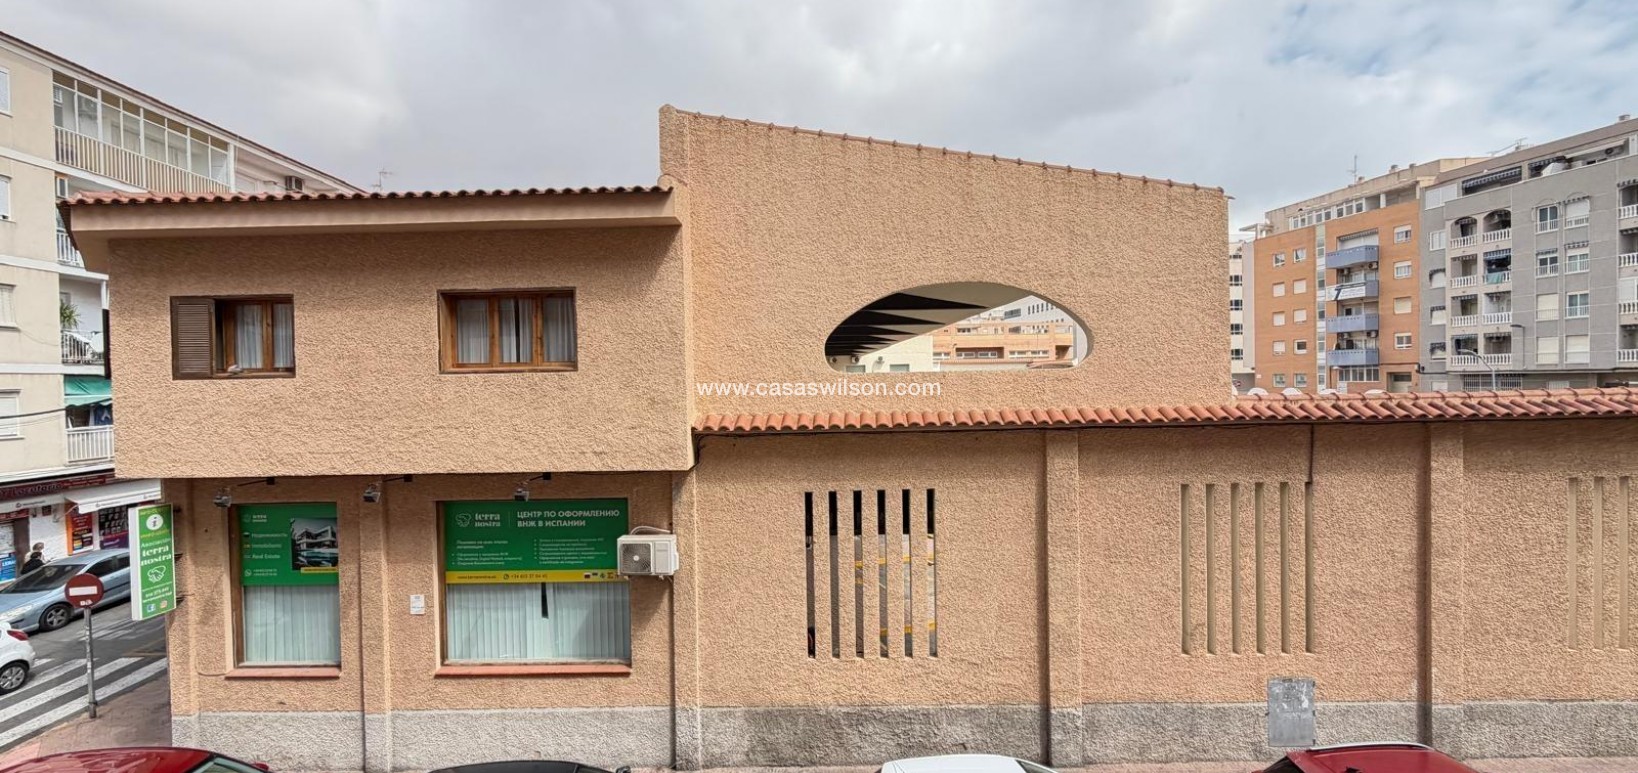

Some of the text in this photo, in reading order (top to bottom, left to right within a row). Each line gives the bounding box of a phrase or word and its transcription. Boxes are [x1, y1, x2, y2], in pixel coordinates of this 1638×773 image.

[474, 512, 501, 520] terra
[517, 509, 620, 519] ЦЕНТР ПО ОФОРМЛЕНИЮ
[517, 520, 536, 528] ВНЖ
[545, 519, 586, 527] ИСПАНИИ
[142, 545, 169, 557] terra
[140, 554, 172, 566] nostra
